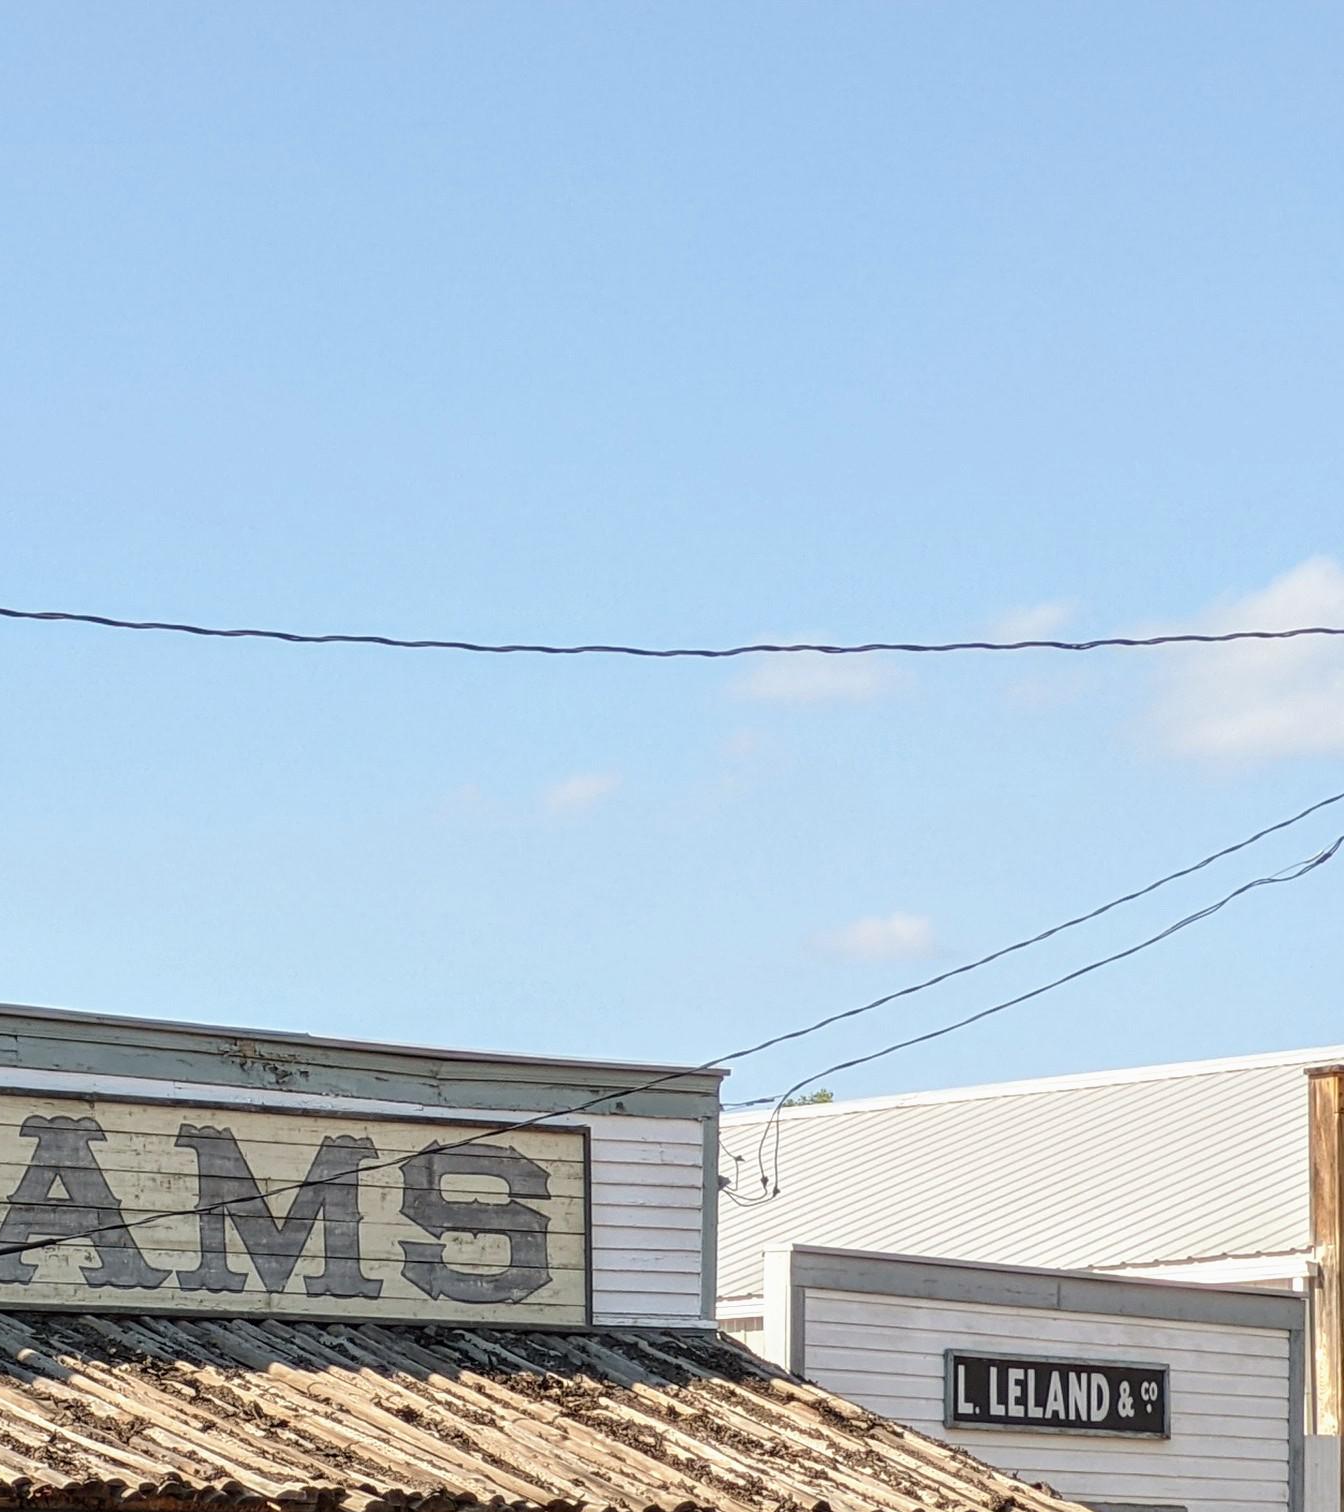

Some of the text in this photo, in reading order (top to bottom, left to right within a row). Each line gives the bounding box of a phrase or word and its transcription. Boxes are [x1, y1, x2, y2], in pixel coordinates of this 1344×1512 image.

[957, 1364, 980, 1414] L.
[989, 1366, 1110, 1422] LELAND
[1117, 1380, 1135, 1418] &
